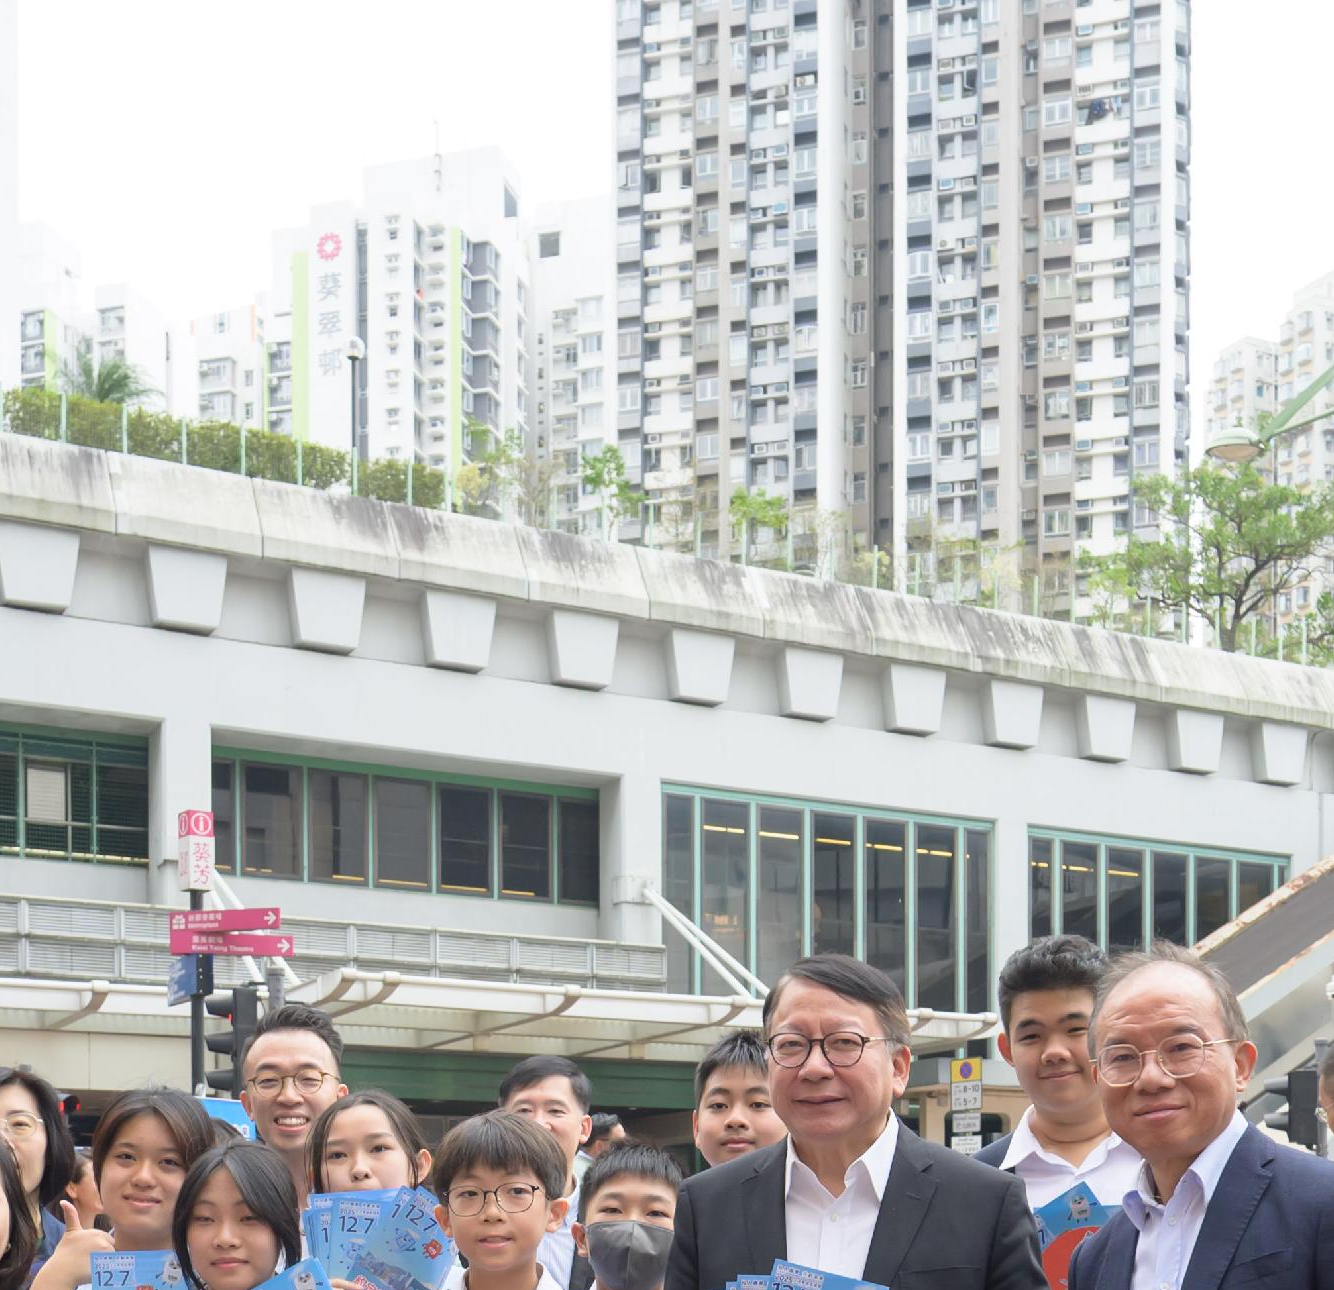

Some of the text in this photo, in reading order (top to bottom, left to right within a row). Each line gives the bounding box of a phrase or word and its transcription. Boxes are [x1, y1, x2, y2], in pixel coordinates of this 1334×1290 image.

[318, 273, 342, 376] 葵翠邨
[193, 842, 212, 885] 葵芳
